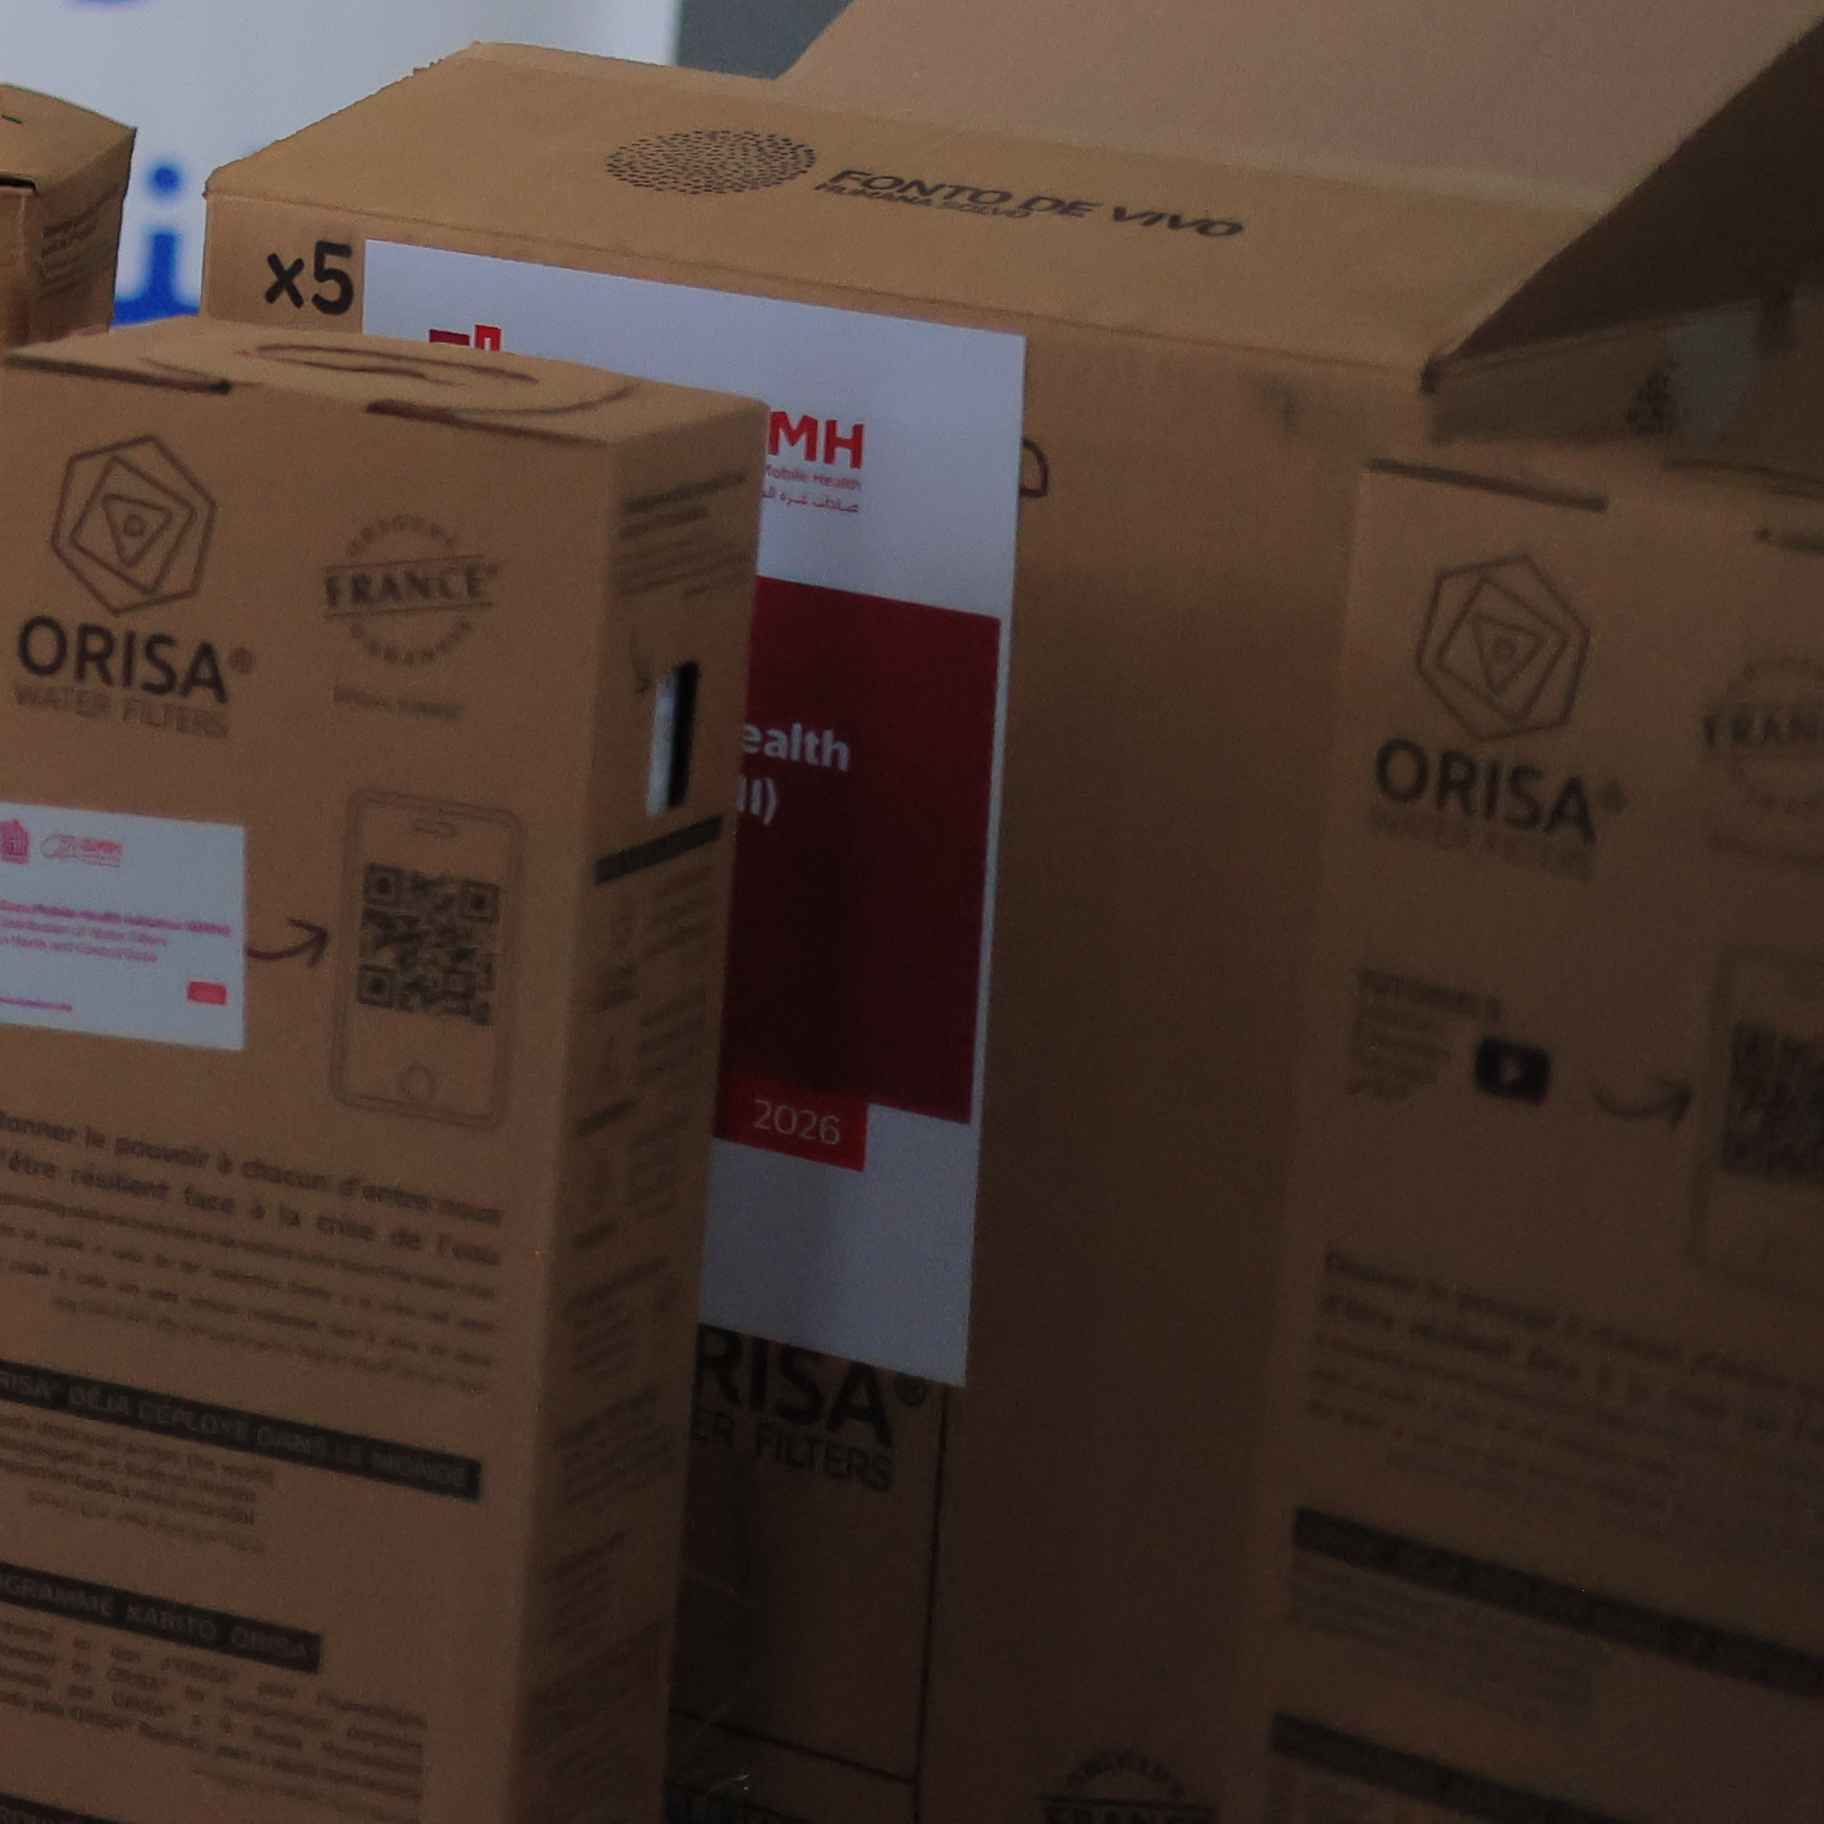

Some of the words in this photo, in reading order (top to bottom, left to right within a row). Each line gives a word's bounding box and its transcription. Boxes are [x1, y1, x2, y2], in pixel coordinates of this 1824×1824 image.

[828, 170, 1012, 204] FONTO
[1021, 196, 1102, 217] DE
[1113, 206, 1244, 237] VIVO
[263, 241, 355, 315] x5
[768, 411, 864, 469] MH
[14, 682, 110, 721] WATER
[123, 698, 228, 739] FILTERS
[743, 723, 849, 771] ealth
[754, 1100, 841, 1146] 2026
[124, 1603, 218, 1643] KARITO
